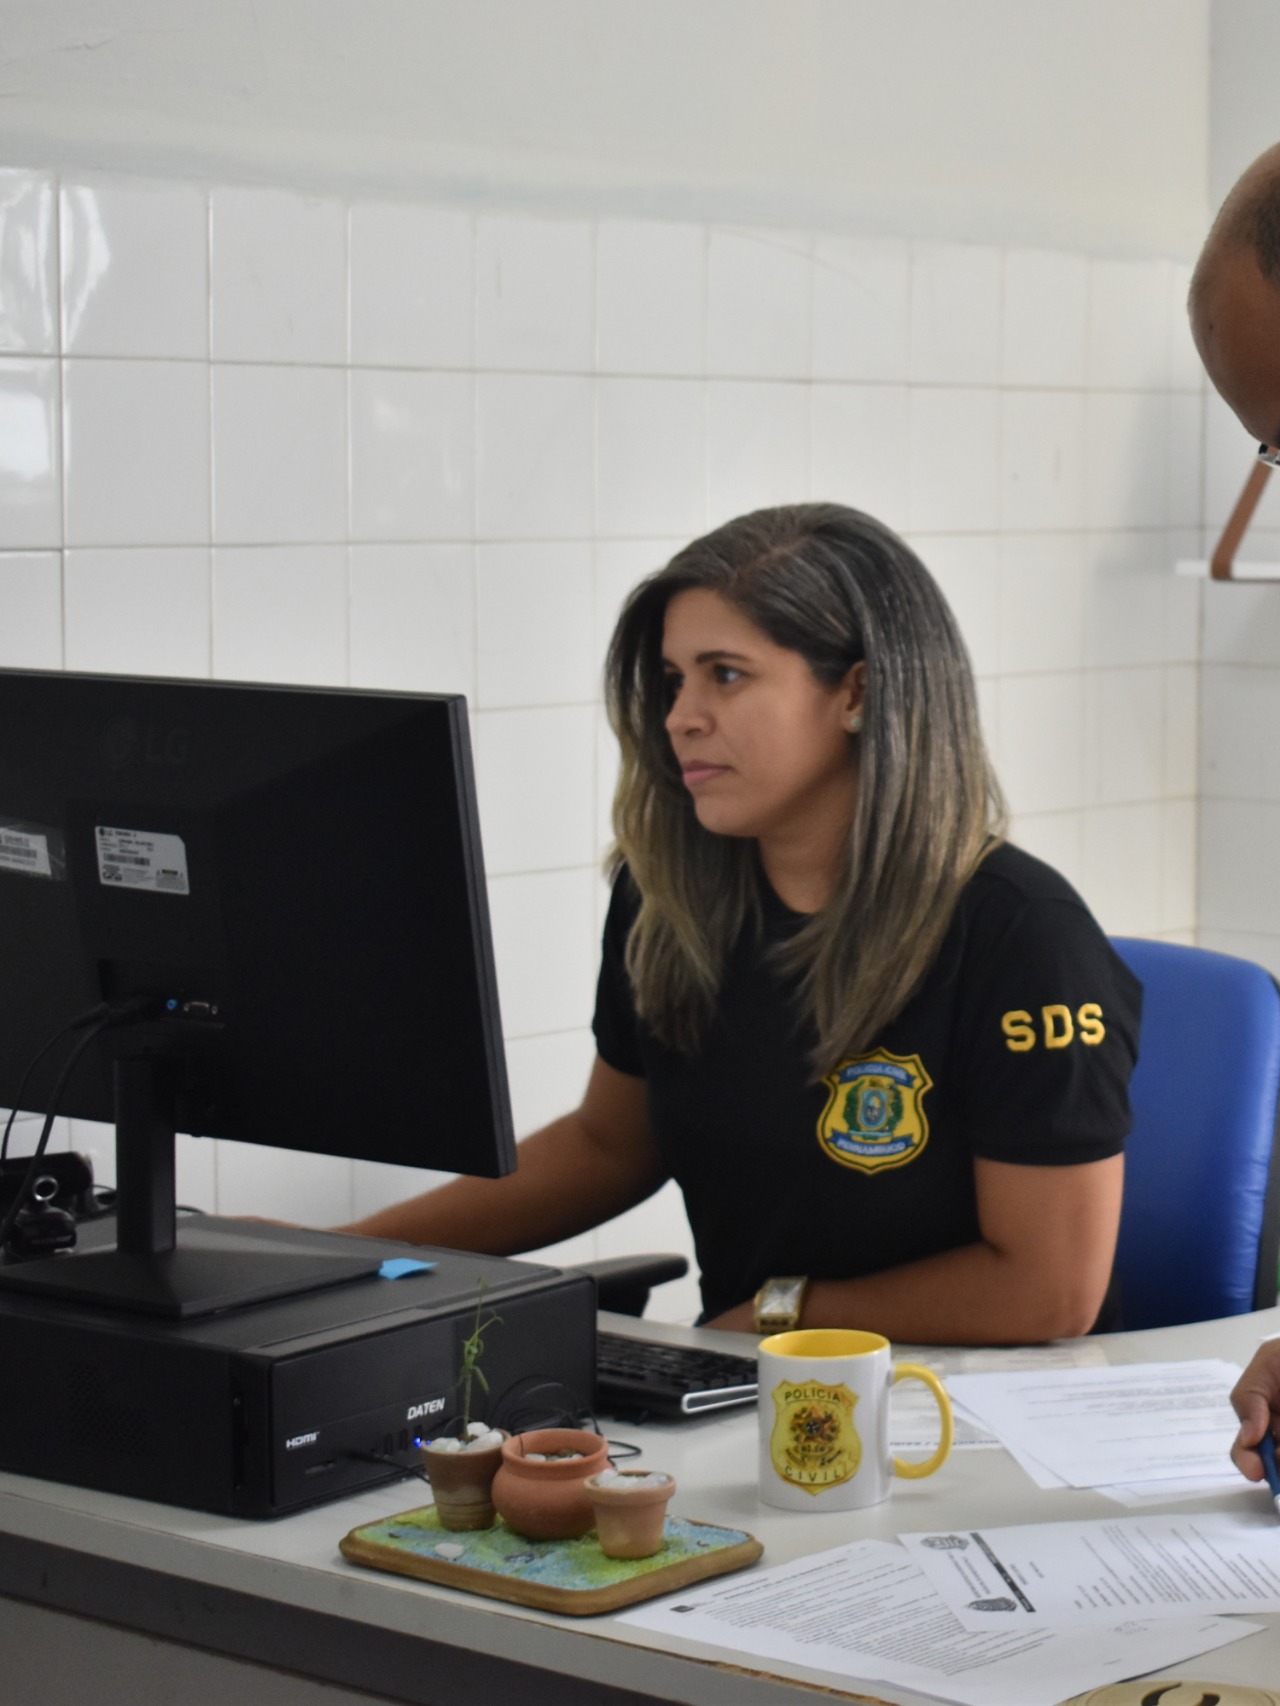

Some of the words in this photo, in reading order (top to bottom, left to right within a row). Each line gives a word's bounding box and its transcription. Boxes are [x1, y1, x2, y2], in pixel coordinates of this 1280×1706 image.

[145, 723, 189, 765] LG
[1001, 1003, 1106, 1052] SDS
[406, 1397, 445, 1421] DATEN
[285, 1431, 318, 1449] HDMI
[784, 1465, 840, 1482] CIVIL
